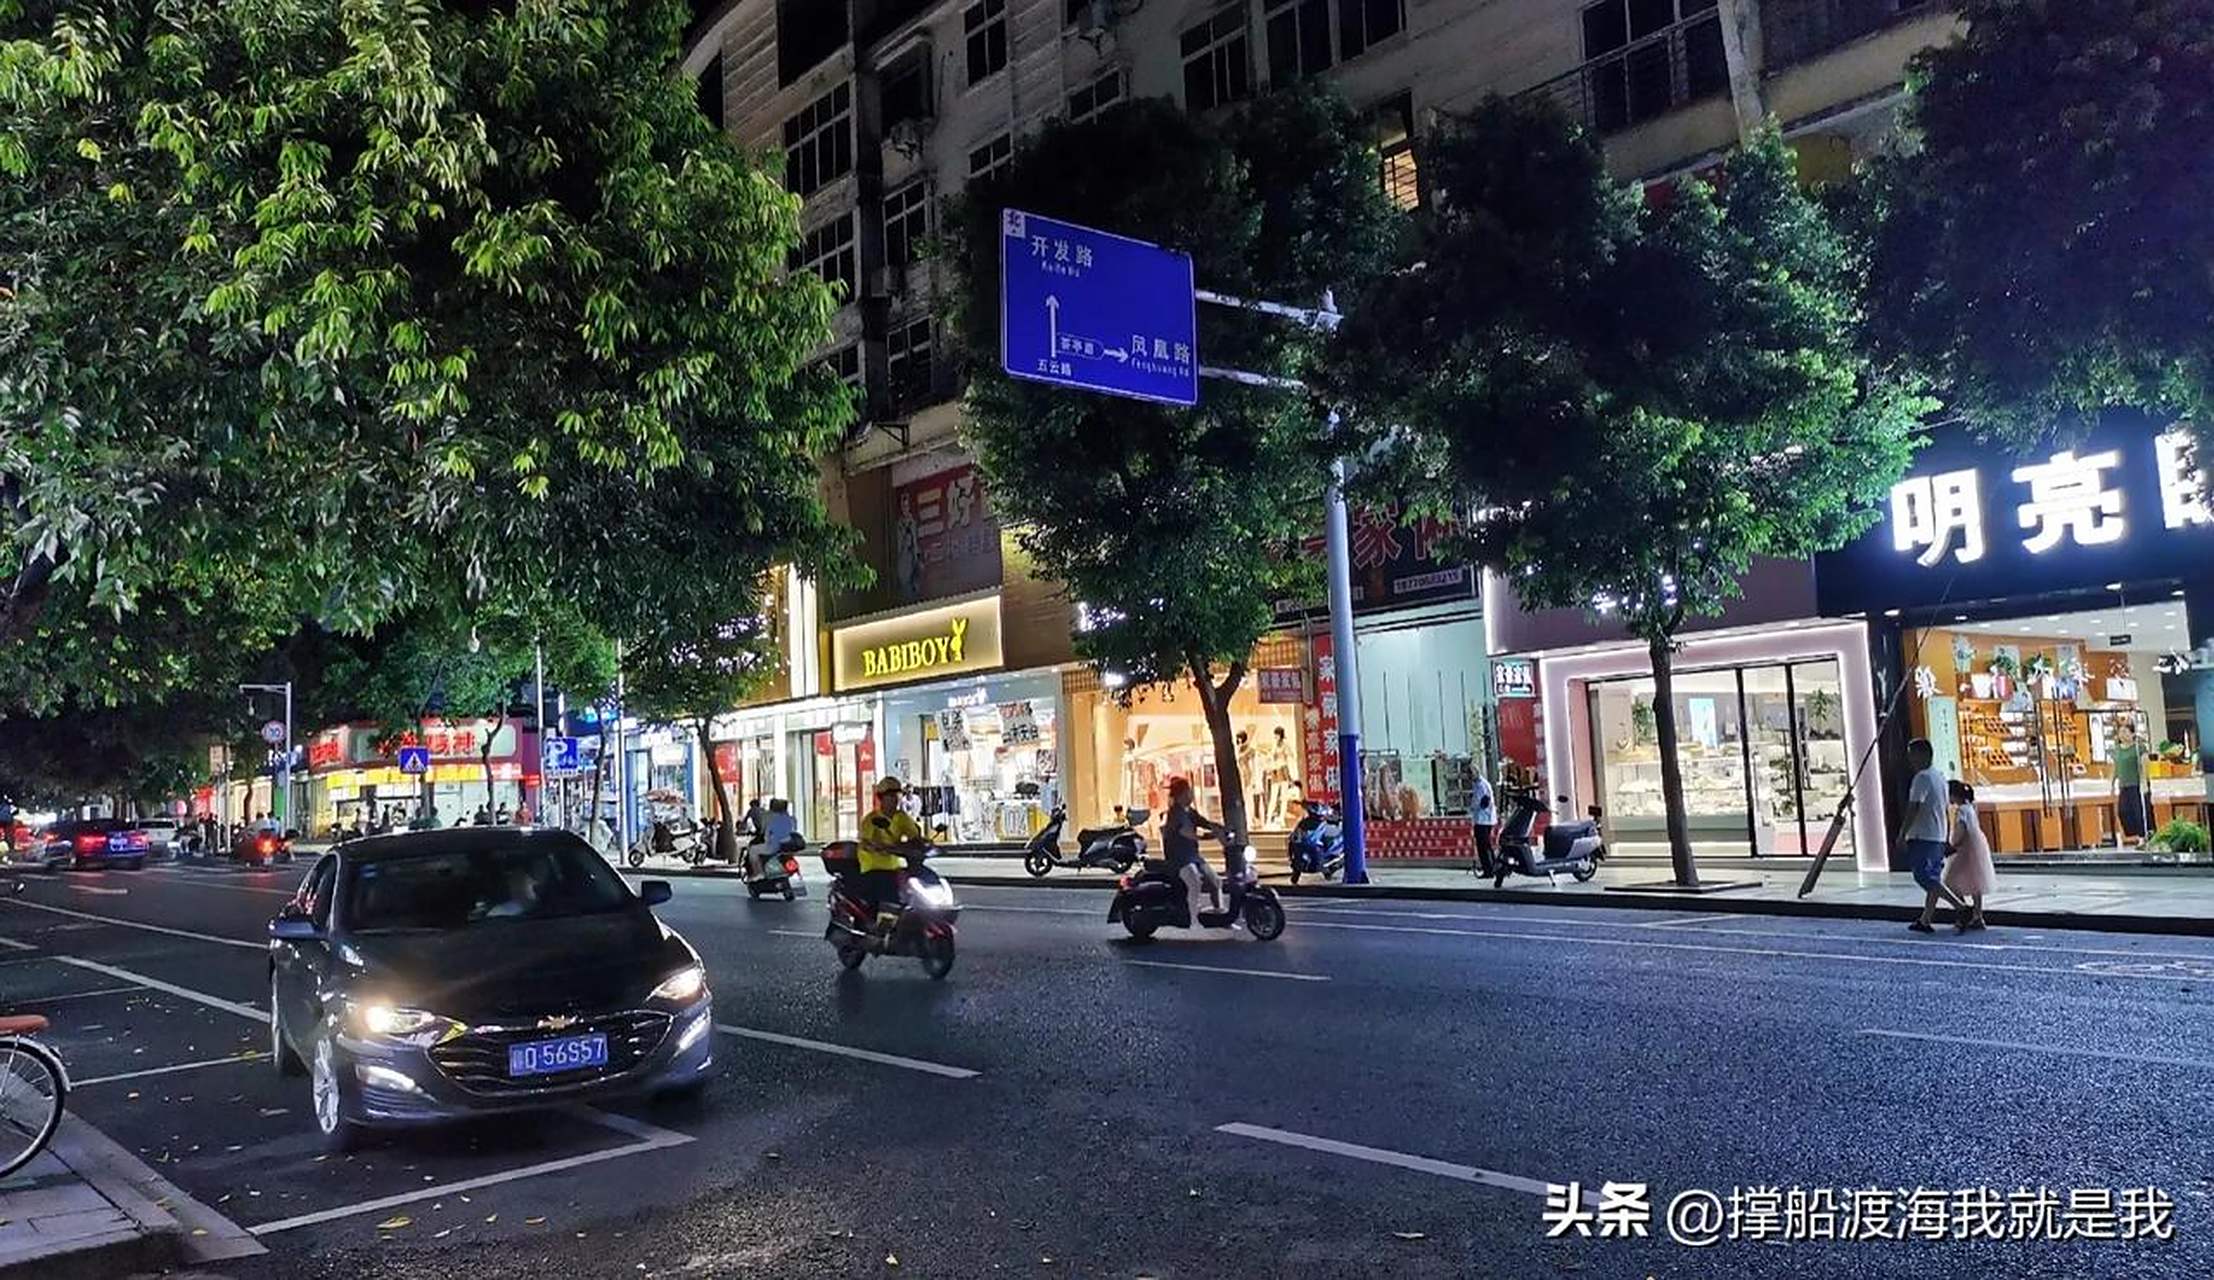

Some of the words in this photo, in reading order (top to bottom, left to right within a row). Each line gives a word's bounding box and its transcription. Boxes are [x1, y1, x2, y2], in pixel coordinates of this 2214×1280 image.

[1031, 234, 1093, 268] 开发路
[1131, 334, 1191, 364] 凤凰路
[863, 635, 950, 676] BABIBOY
